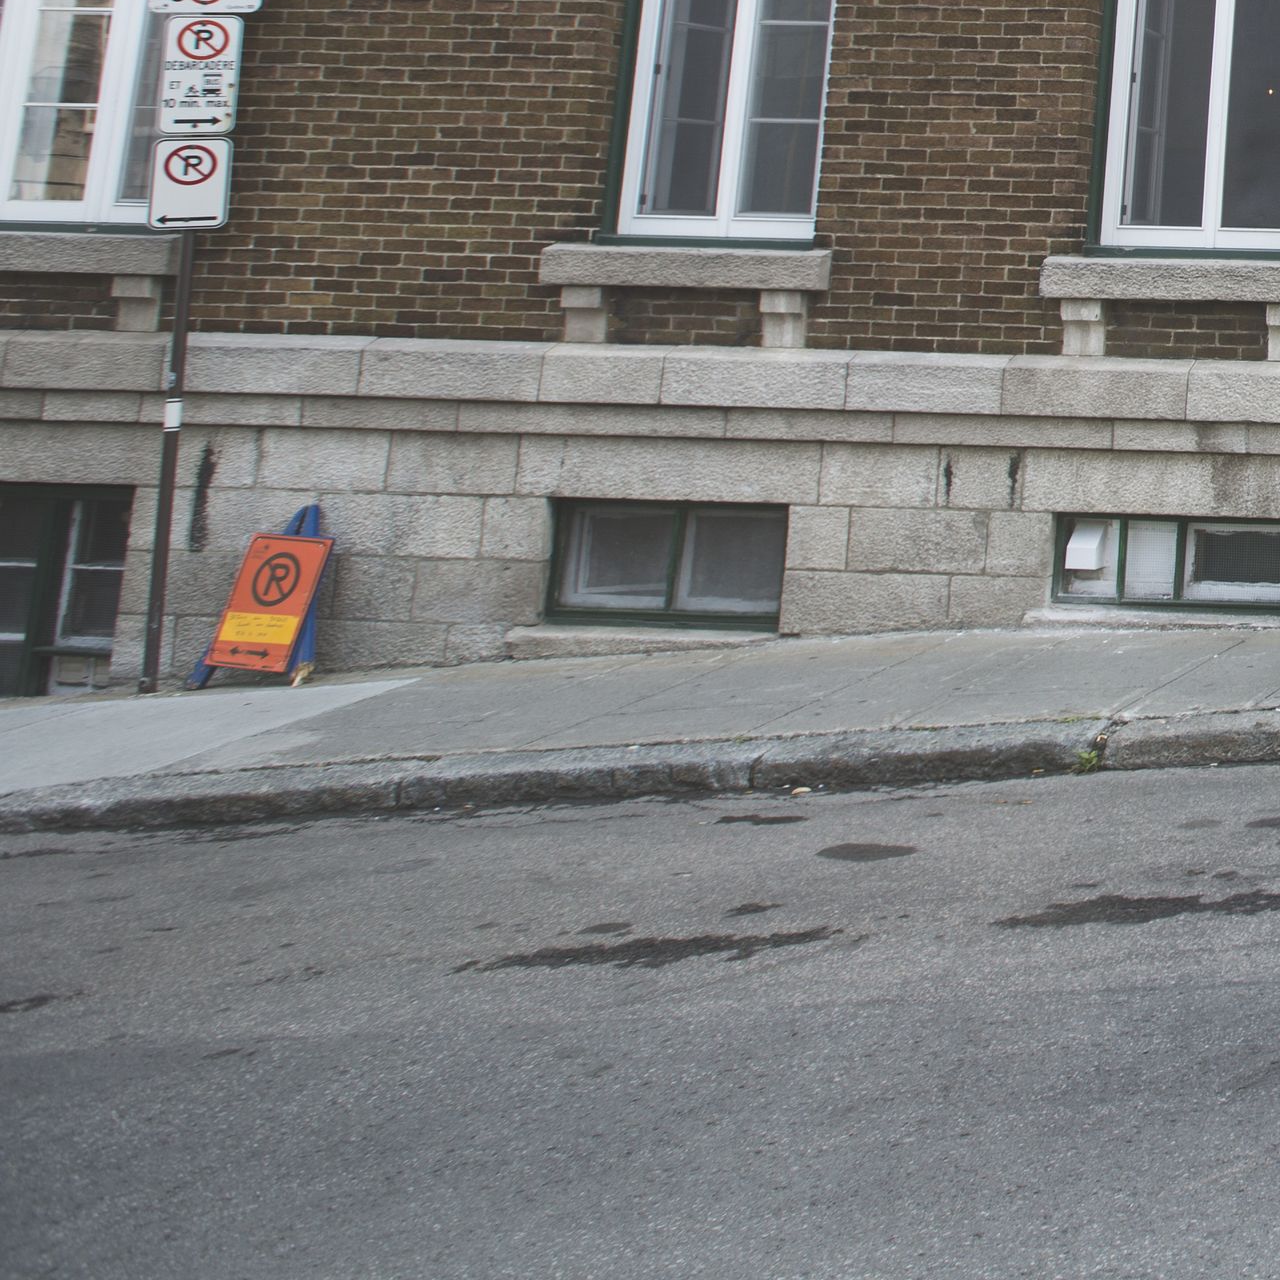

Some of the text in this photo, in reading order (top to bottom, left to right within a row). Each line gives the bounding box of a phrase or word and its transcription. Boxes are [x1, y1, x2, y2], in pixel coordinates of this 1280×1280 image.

[169, 80, 181, 90] ET
[163, 98, 232, 108] 10 min. max.
